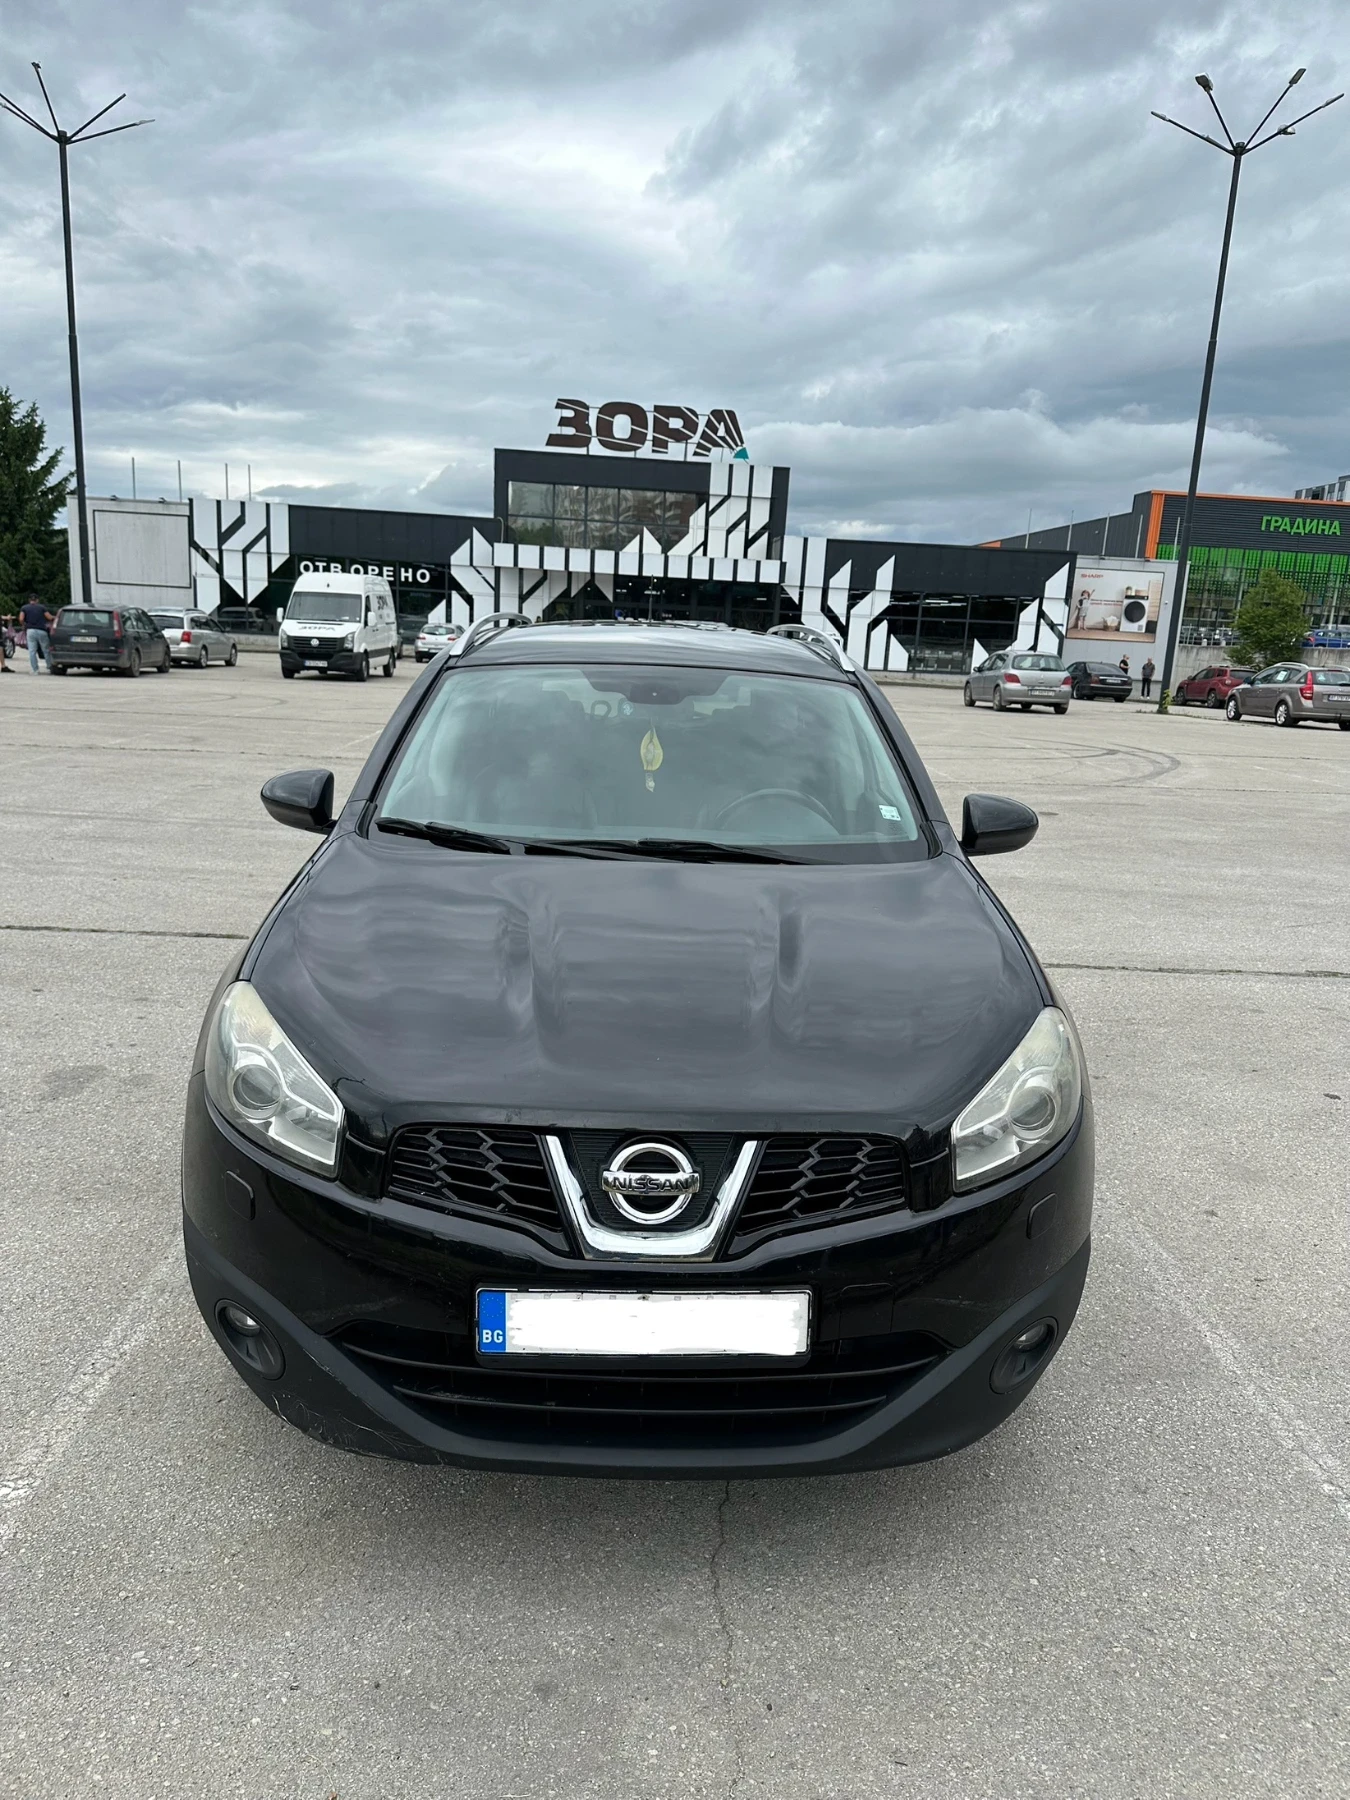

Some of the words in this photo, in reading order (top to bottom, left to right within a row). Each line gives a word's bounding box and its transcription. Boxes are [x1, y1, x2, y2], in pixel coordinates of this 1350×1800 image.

[545, 398, 749, 459] ЗОРА
[1261, 515, 1341, 536] ГРАДИНА
[611, 1176, 691, 1193] NISSAN
[483, 1330, 504, 1344] BG
